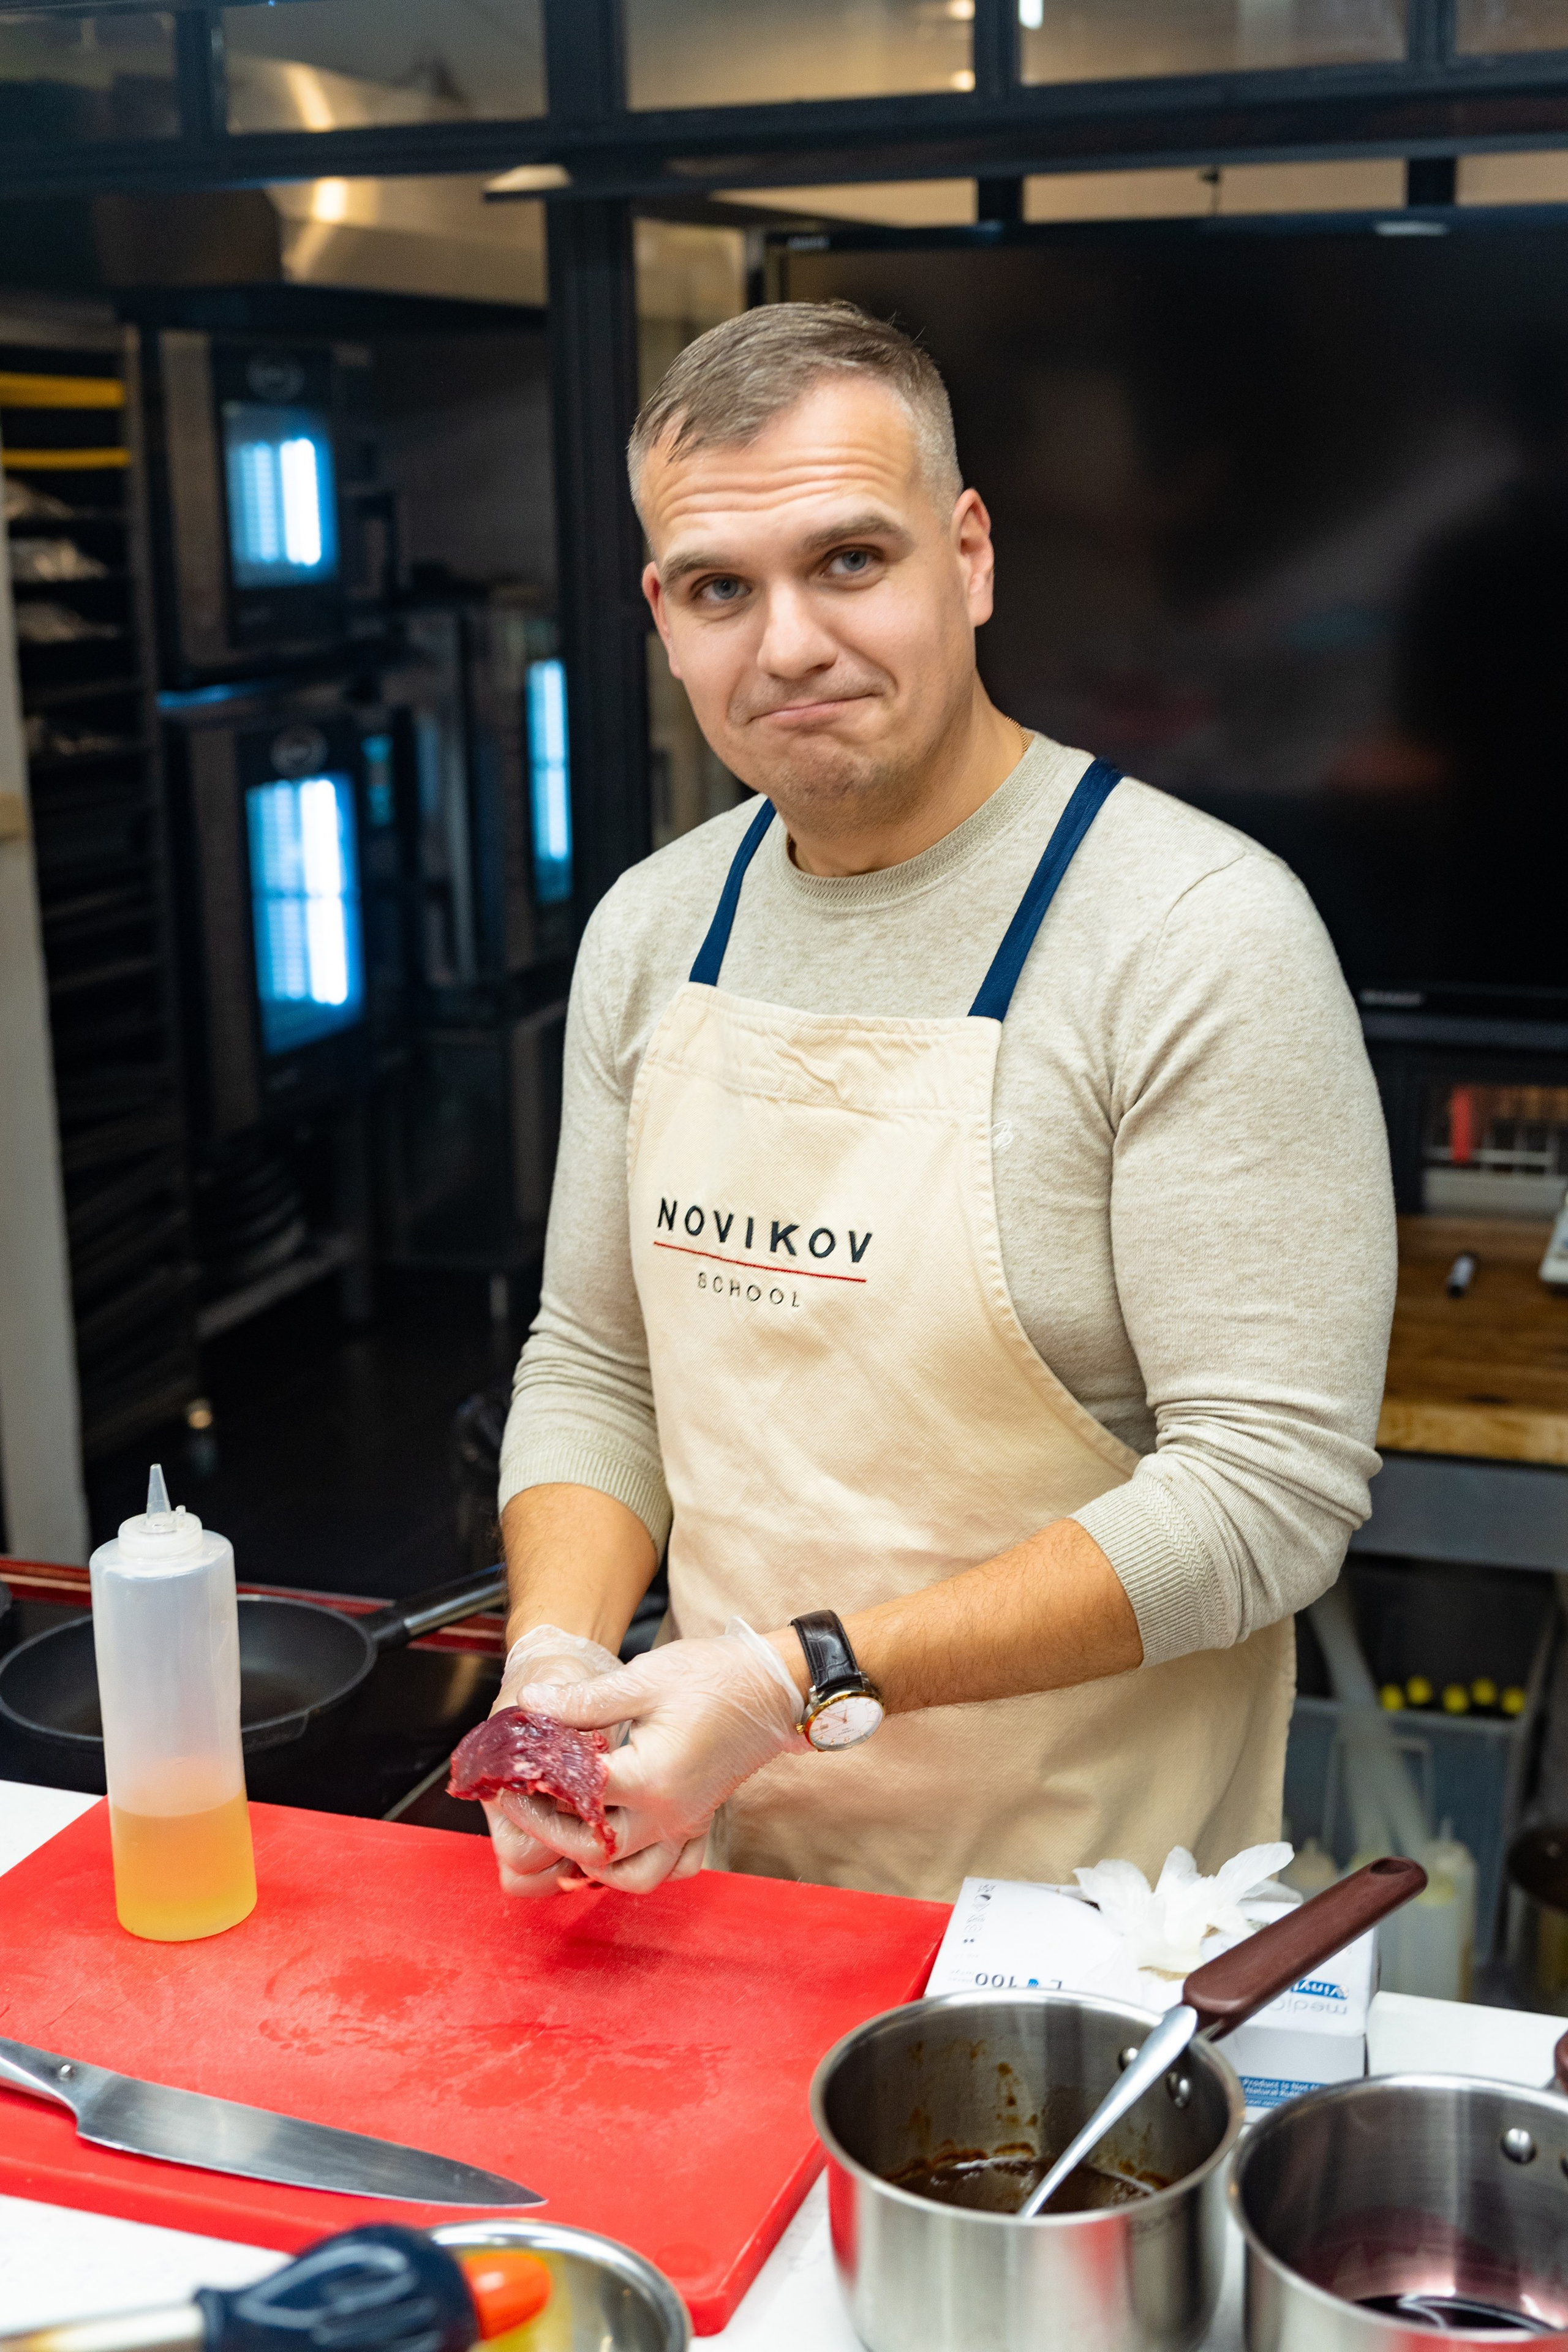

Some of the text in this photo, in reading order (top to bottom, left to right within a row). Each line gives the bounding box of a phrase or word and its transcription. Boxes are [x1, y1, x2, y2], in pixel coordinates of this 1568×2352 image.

[657, 1197, 872, 1263] NOVIKOV
[698, 1272, 800, 1307] SCHOOL
[975, 1973, 1017, 1988] 100
